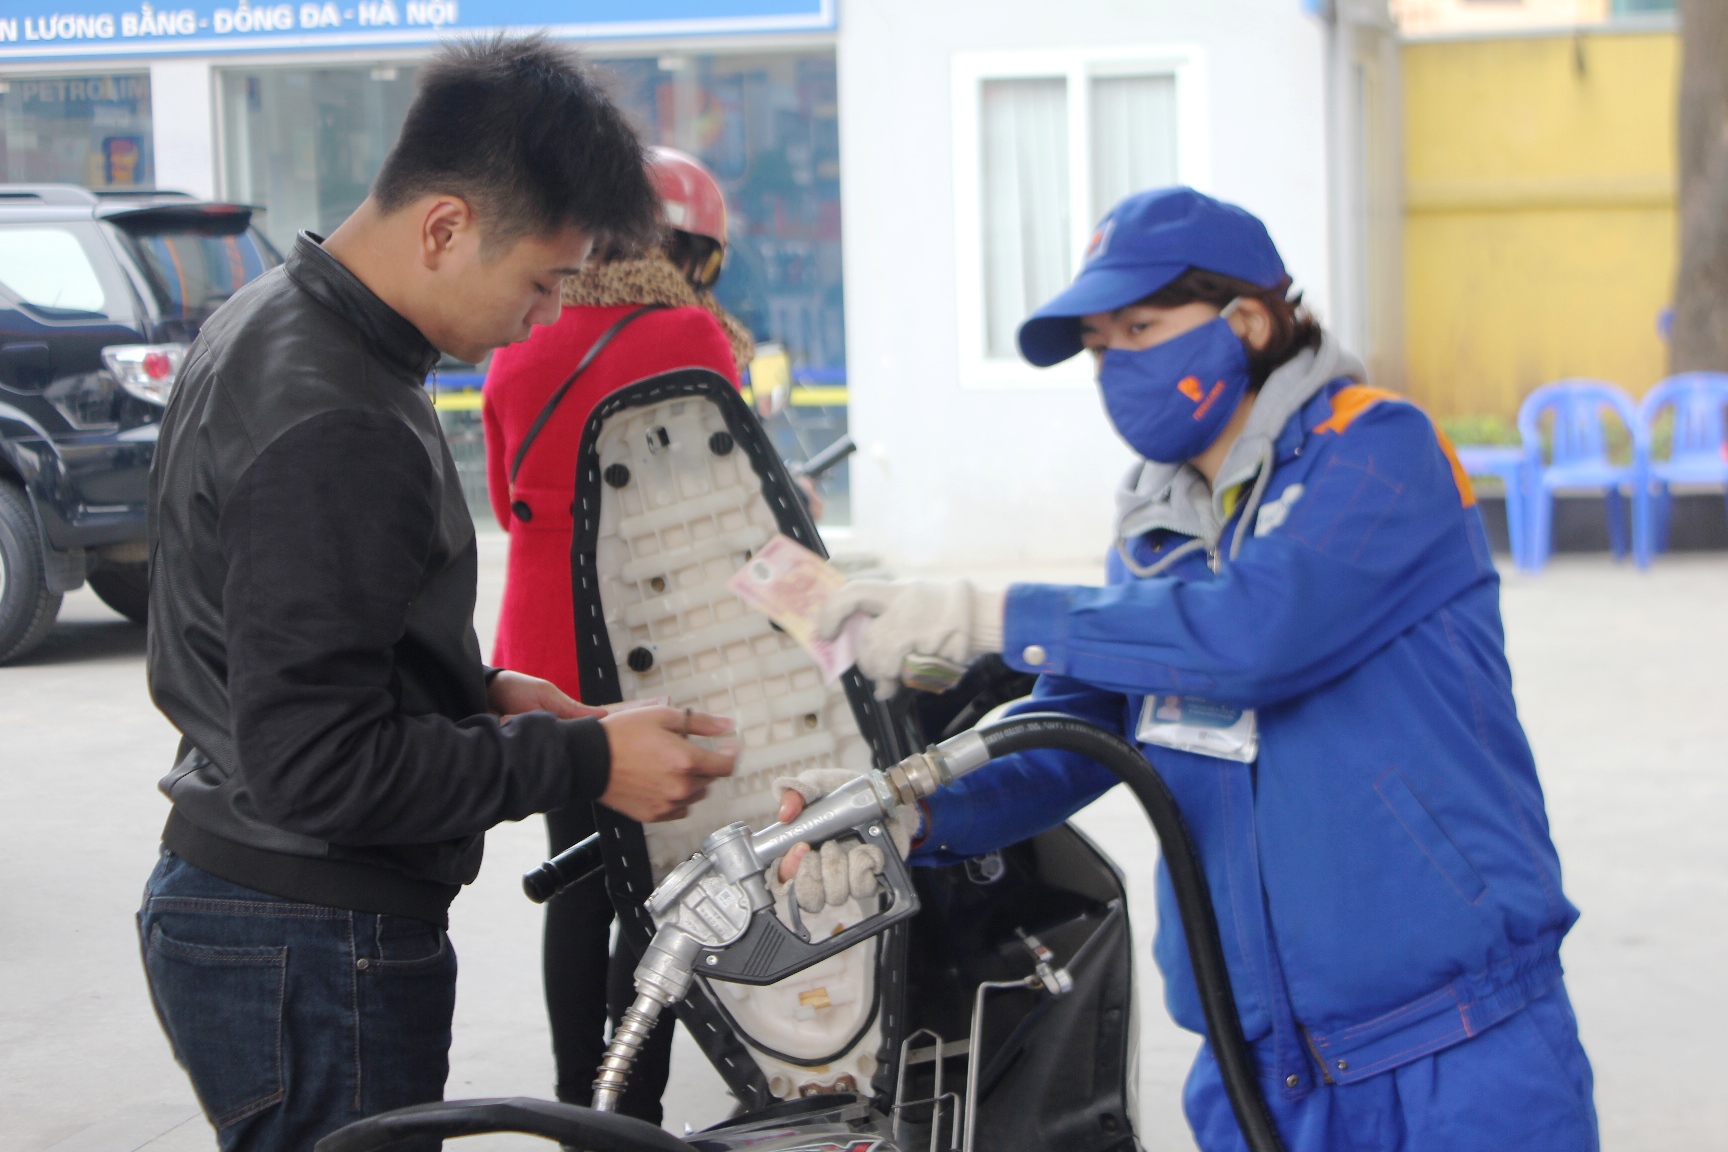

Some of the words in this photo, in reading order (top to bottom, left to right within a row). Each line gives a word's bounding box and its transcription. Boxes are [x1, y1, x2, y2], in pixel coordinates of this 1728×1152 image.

[24, 13, 115, 41] LƯƠNG
[300, 3, 340, 29] ĐA
[769, 810, 835, 845] TATSUNO
